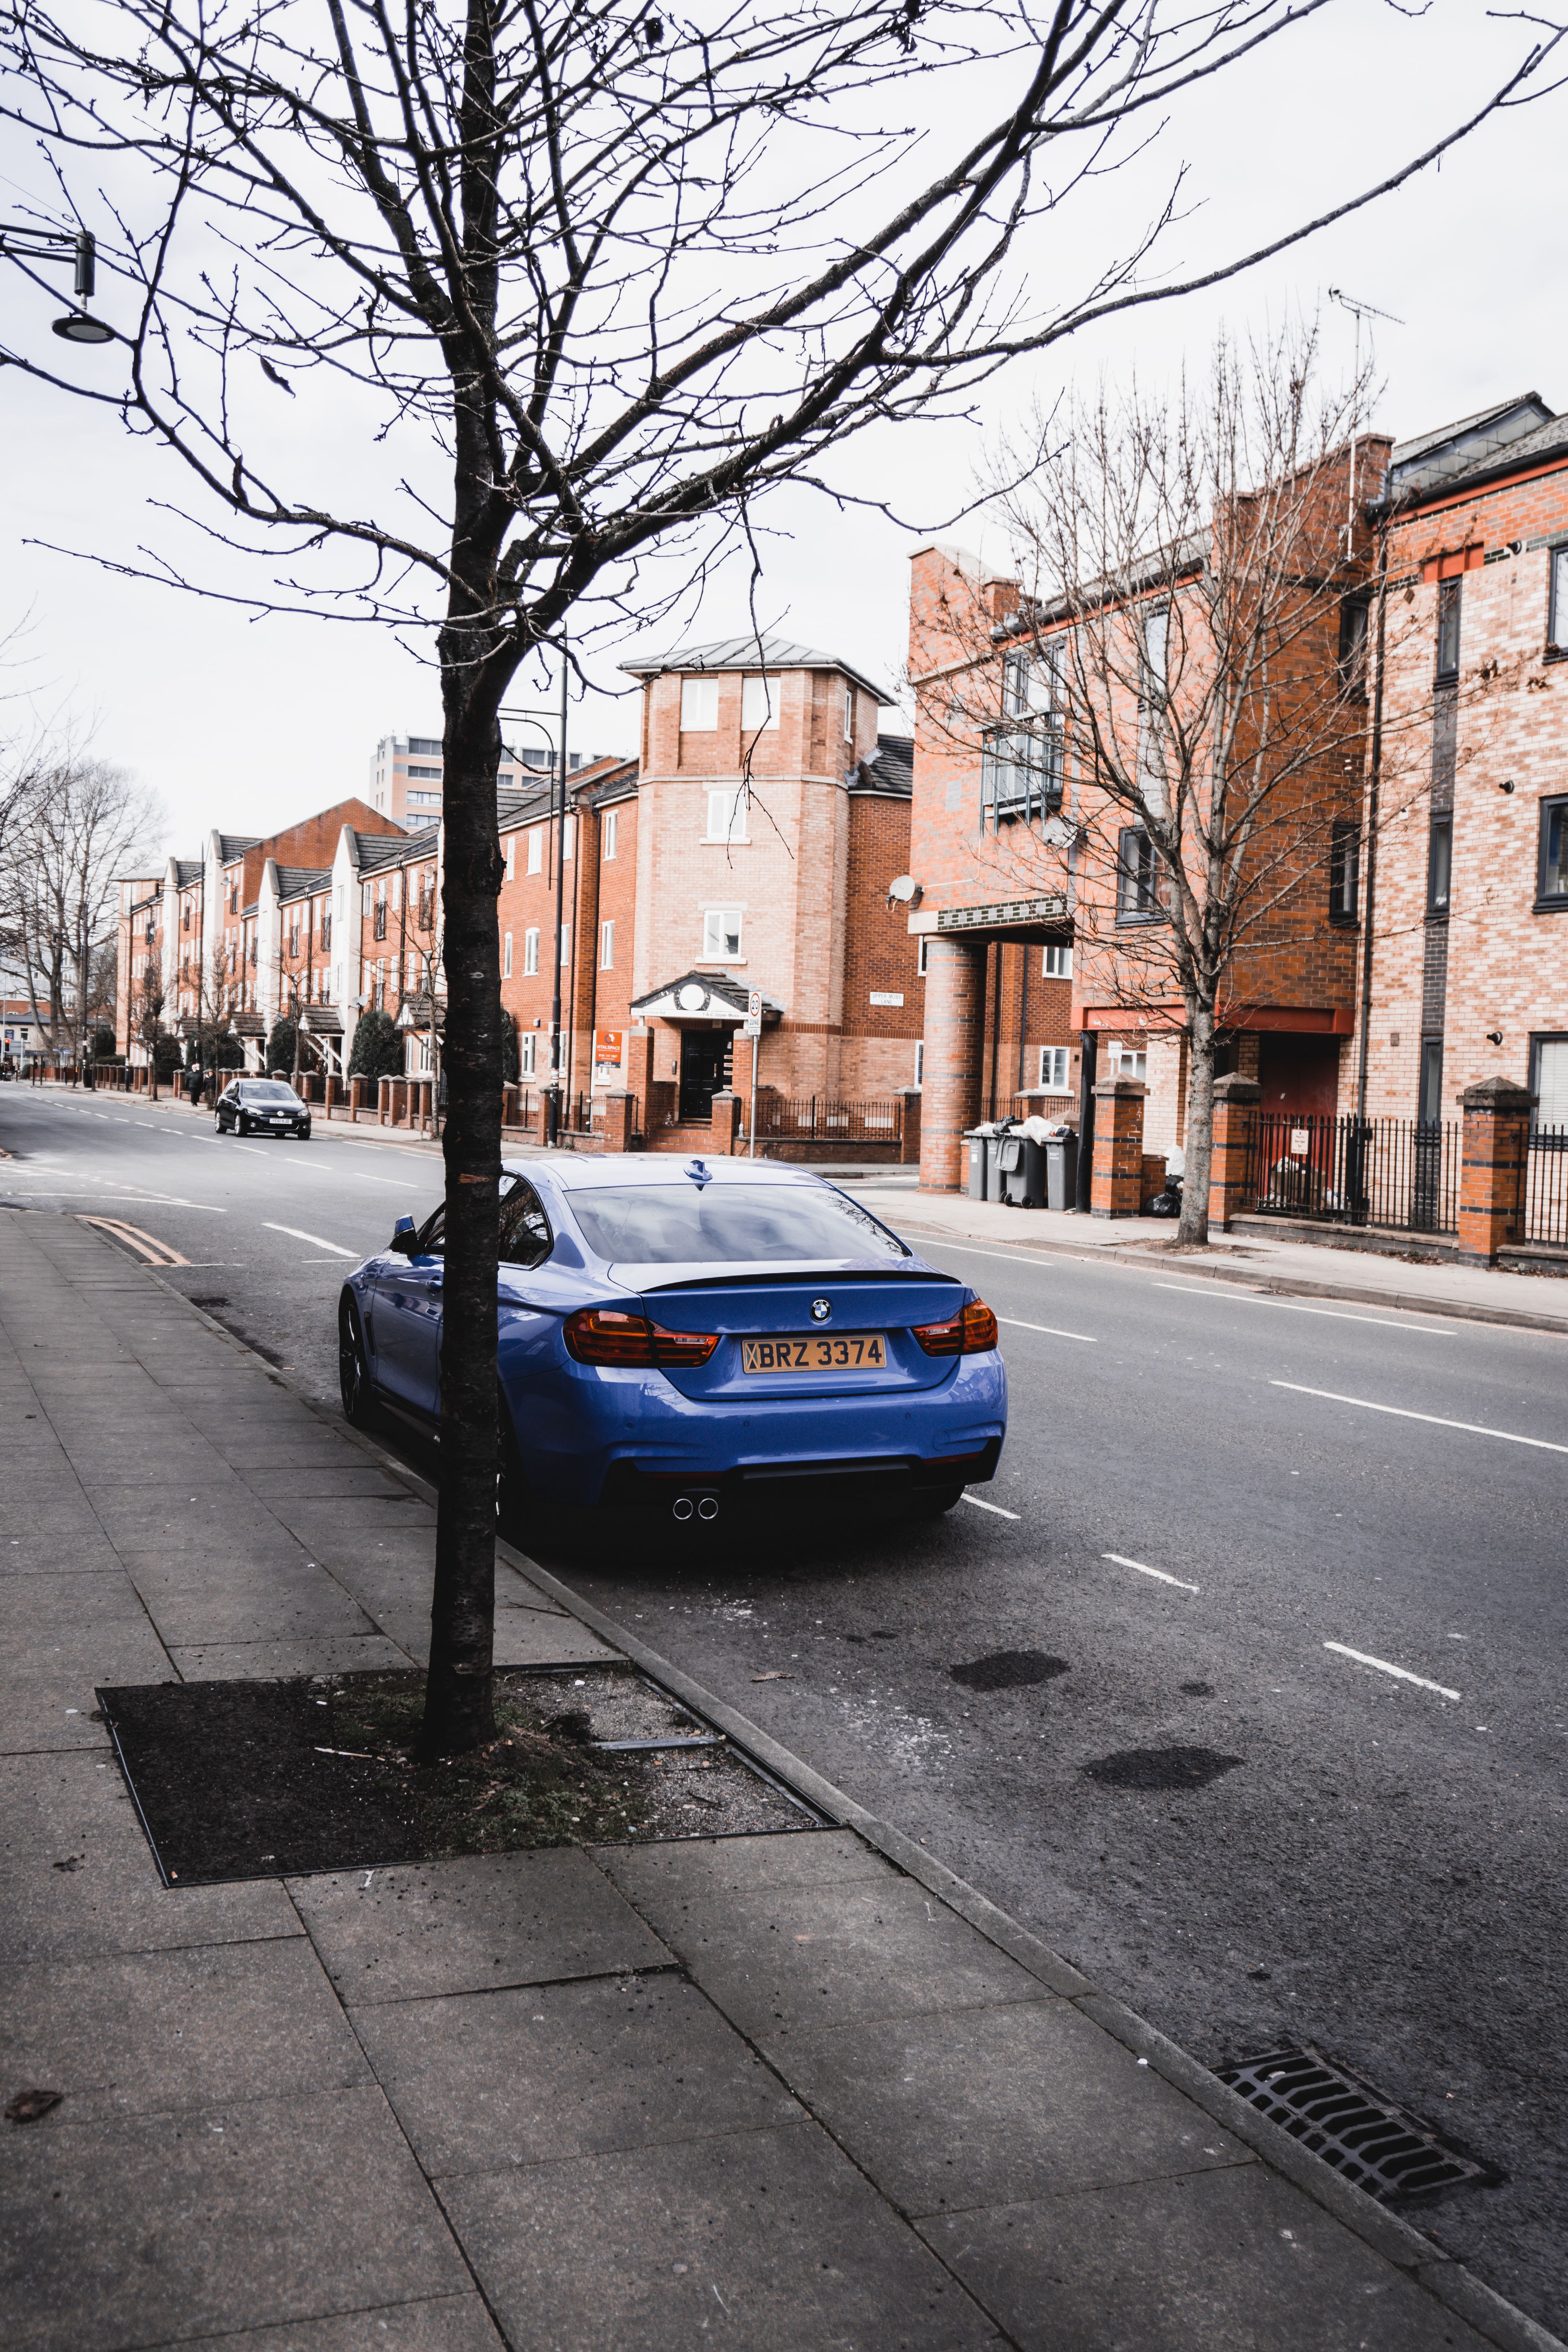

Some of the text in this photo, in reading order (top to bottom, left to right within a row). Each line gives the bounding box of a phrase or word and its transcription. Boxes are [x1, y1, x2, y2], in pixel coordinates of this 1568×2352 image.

[752, 1000, 759, 1009] 20
[758, 1340, 882, 1368] BRZ 3374
